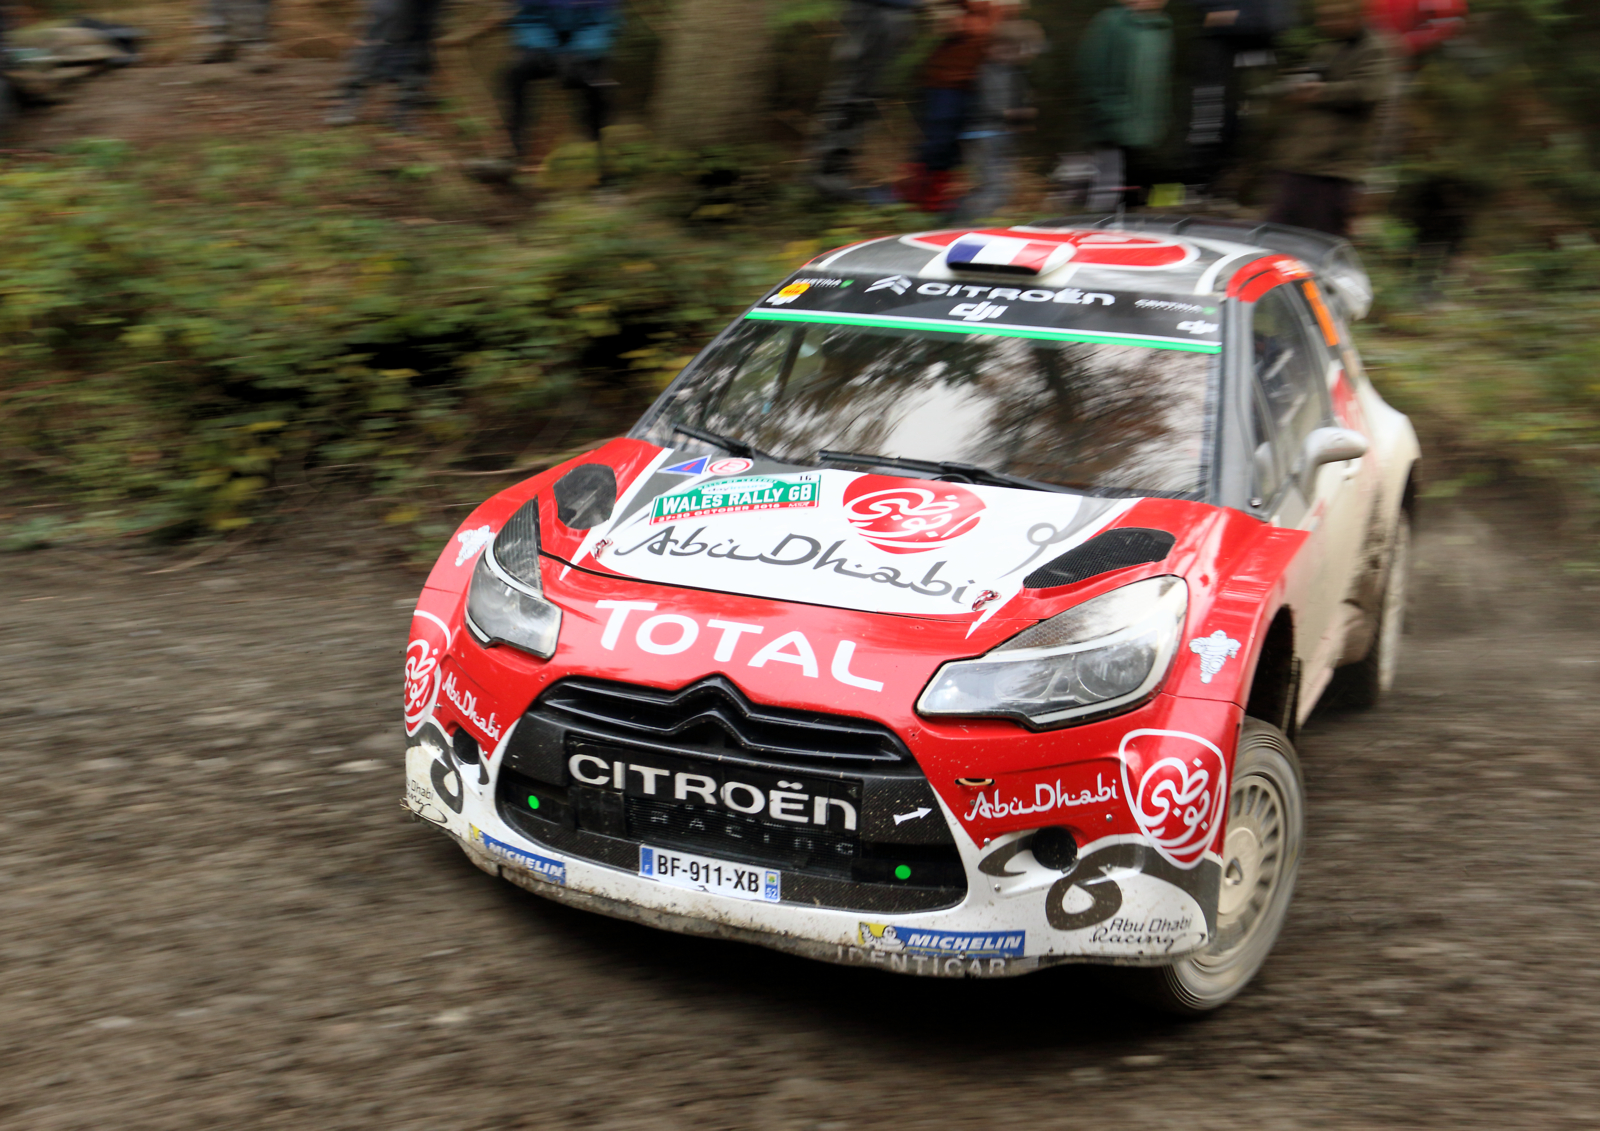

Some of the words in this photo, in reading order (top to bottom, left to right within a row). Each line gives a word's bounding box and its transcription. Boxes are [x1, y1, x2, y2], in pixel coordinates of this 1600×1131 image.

[662, 494, 723, 516] WALES
[728, 486, 785, 507] RALLY
[788, 484, 813, 501] GB
[694, 505, 749, 517] OCTOBER
[595, 600, 884, 692] TOTAL
[488, 842, 564, 877] MICHELIN
[657, 854, 760, 893] BF-911-XB
[765, 887, 778, 898] 52
[1110, 918, 1145, 933] Abu
[1148, 913, 1194, 933] Dhabi
[907, 933, 1023, 950] MICHELIN
